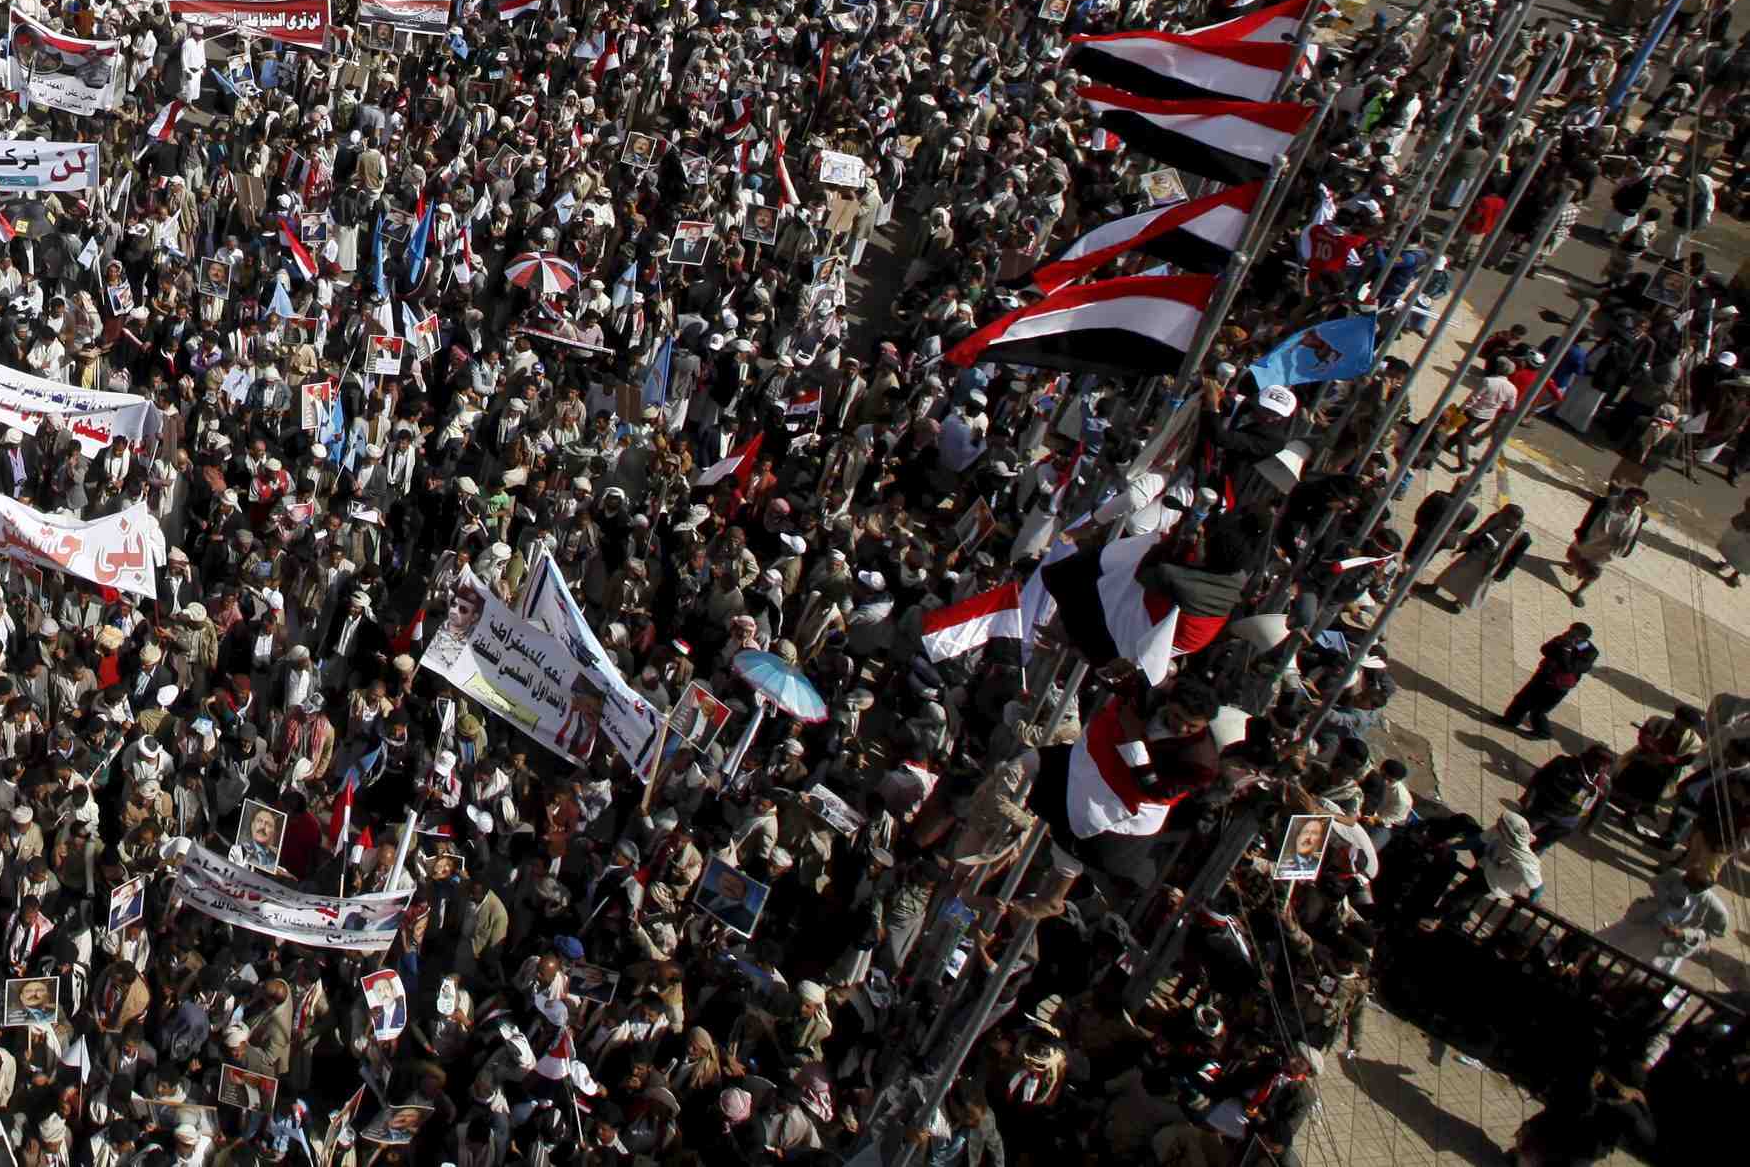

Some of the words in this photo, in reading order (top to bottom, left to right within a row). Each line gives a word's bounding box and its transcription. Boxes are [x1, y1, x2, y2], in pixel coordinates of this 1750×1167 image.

[286, 12, 308, 31] ترى
[308, 12, 322, 29] لن
[49, 148, 89, 183] لن
[93, 515, 147, 585] بني
[489, 613, 547, 669] للديمقراطية
[497, 661, 533, 691] السلمي
[543, 664, 566, 687] نعم
[530, 683, 568, 719] والتداول
